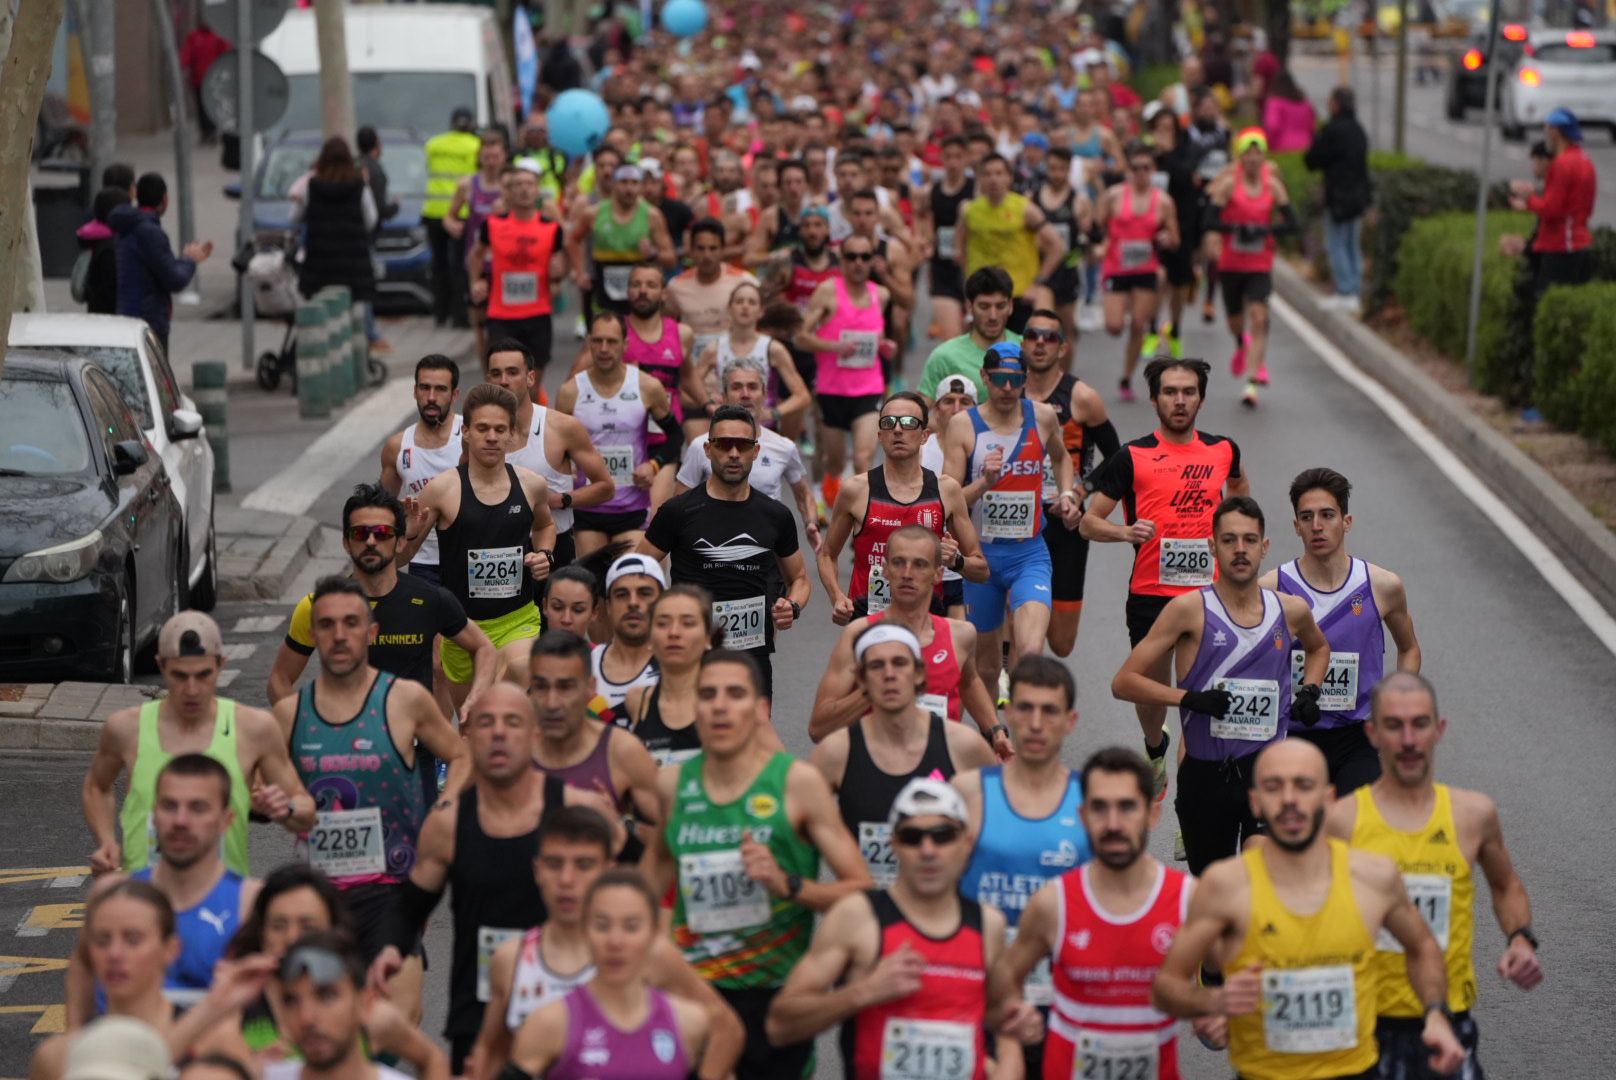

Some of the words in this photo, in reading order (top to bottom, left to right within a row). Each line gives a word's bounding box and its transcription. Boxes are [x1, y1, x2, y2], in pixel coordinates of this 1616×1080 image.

[1180, 464, 1214, 479] RUN
[1184, 480, 1202, 489] FOR
[1169, 489, 1207, 507] LIFE
[988, 503, 1029, 520] 2229
[1165, 551, 1209, 569] 2286
[474, 560, 518, 580] 2264
[484, 578, 510, 586] MUÑOZ
[718, 611, 759, 632] 2210
[379, 633, 424, 645] RUNNERS
[733, 630, 748, 639] IVAN
[1298, 666, 1350, 688] 244
[1319, 688, 1348, 696] ANDRO
[1228, 717, 1261, 725] ALVARO
[316, 826, 372, 851] 2287
[677, 822, 773, 845] Huesa
[691, 871, 756, 902] 2109
[978, 872, 1047, 893] ATLET
[1274, 988, 1344, 1021] 2119
[893, 1041, 964, 1076] 2113
[1081, 1053, 1151, 1080] 2122
